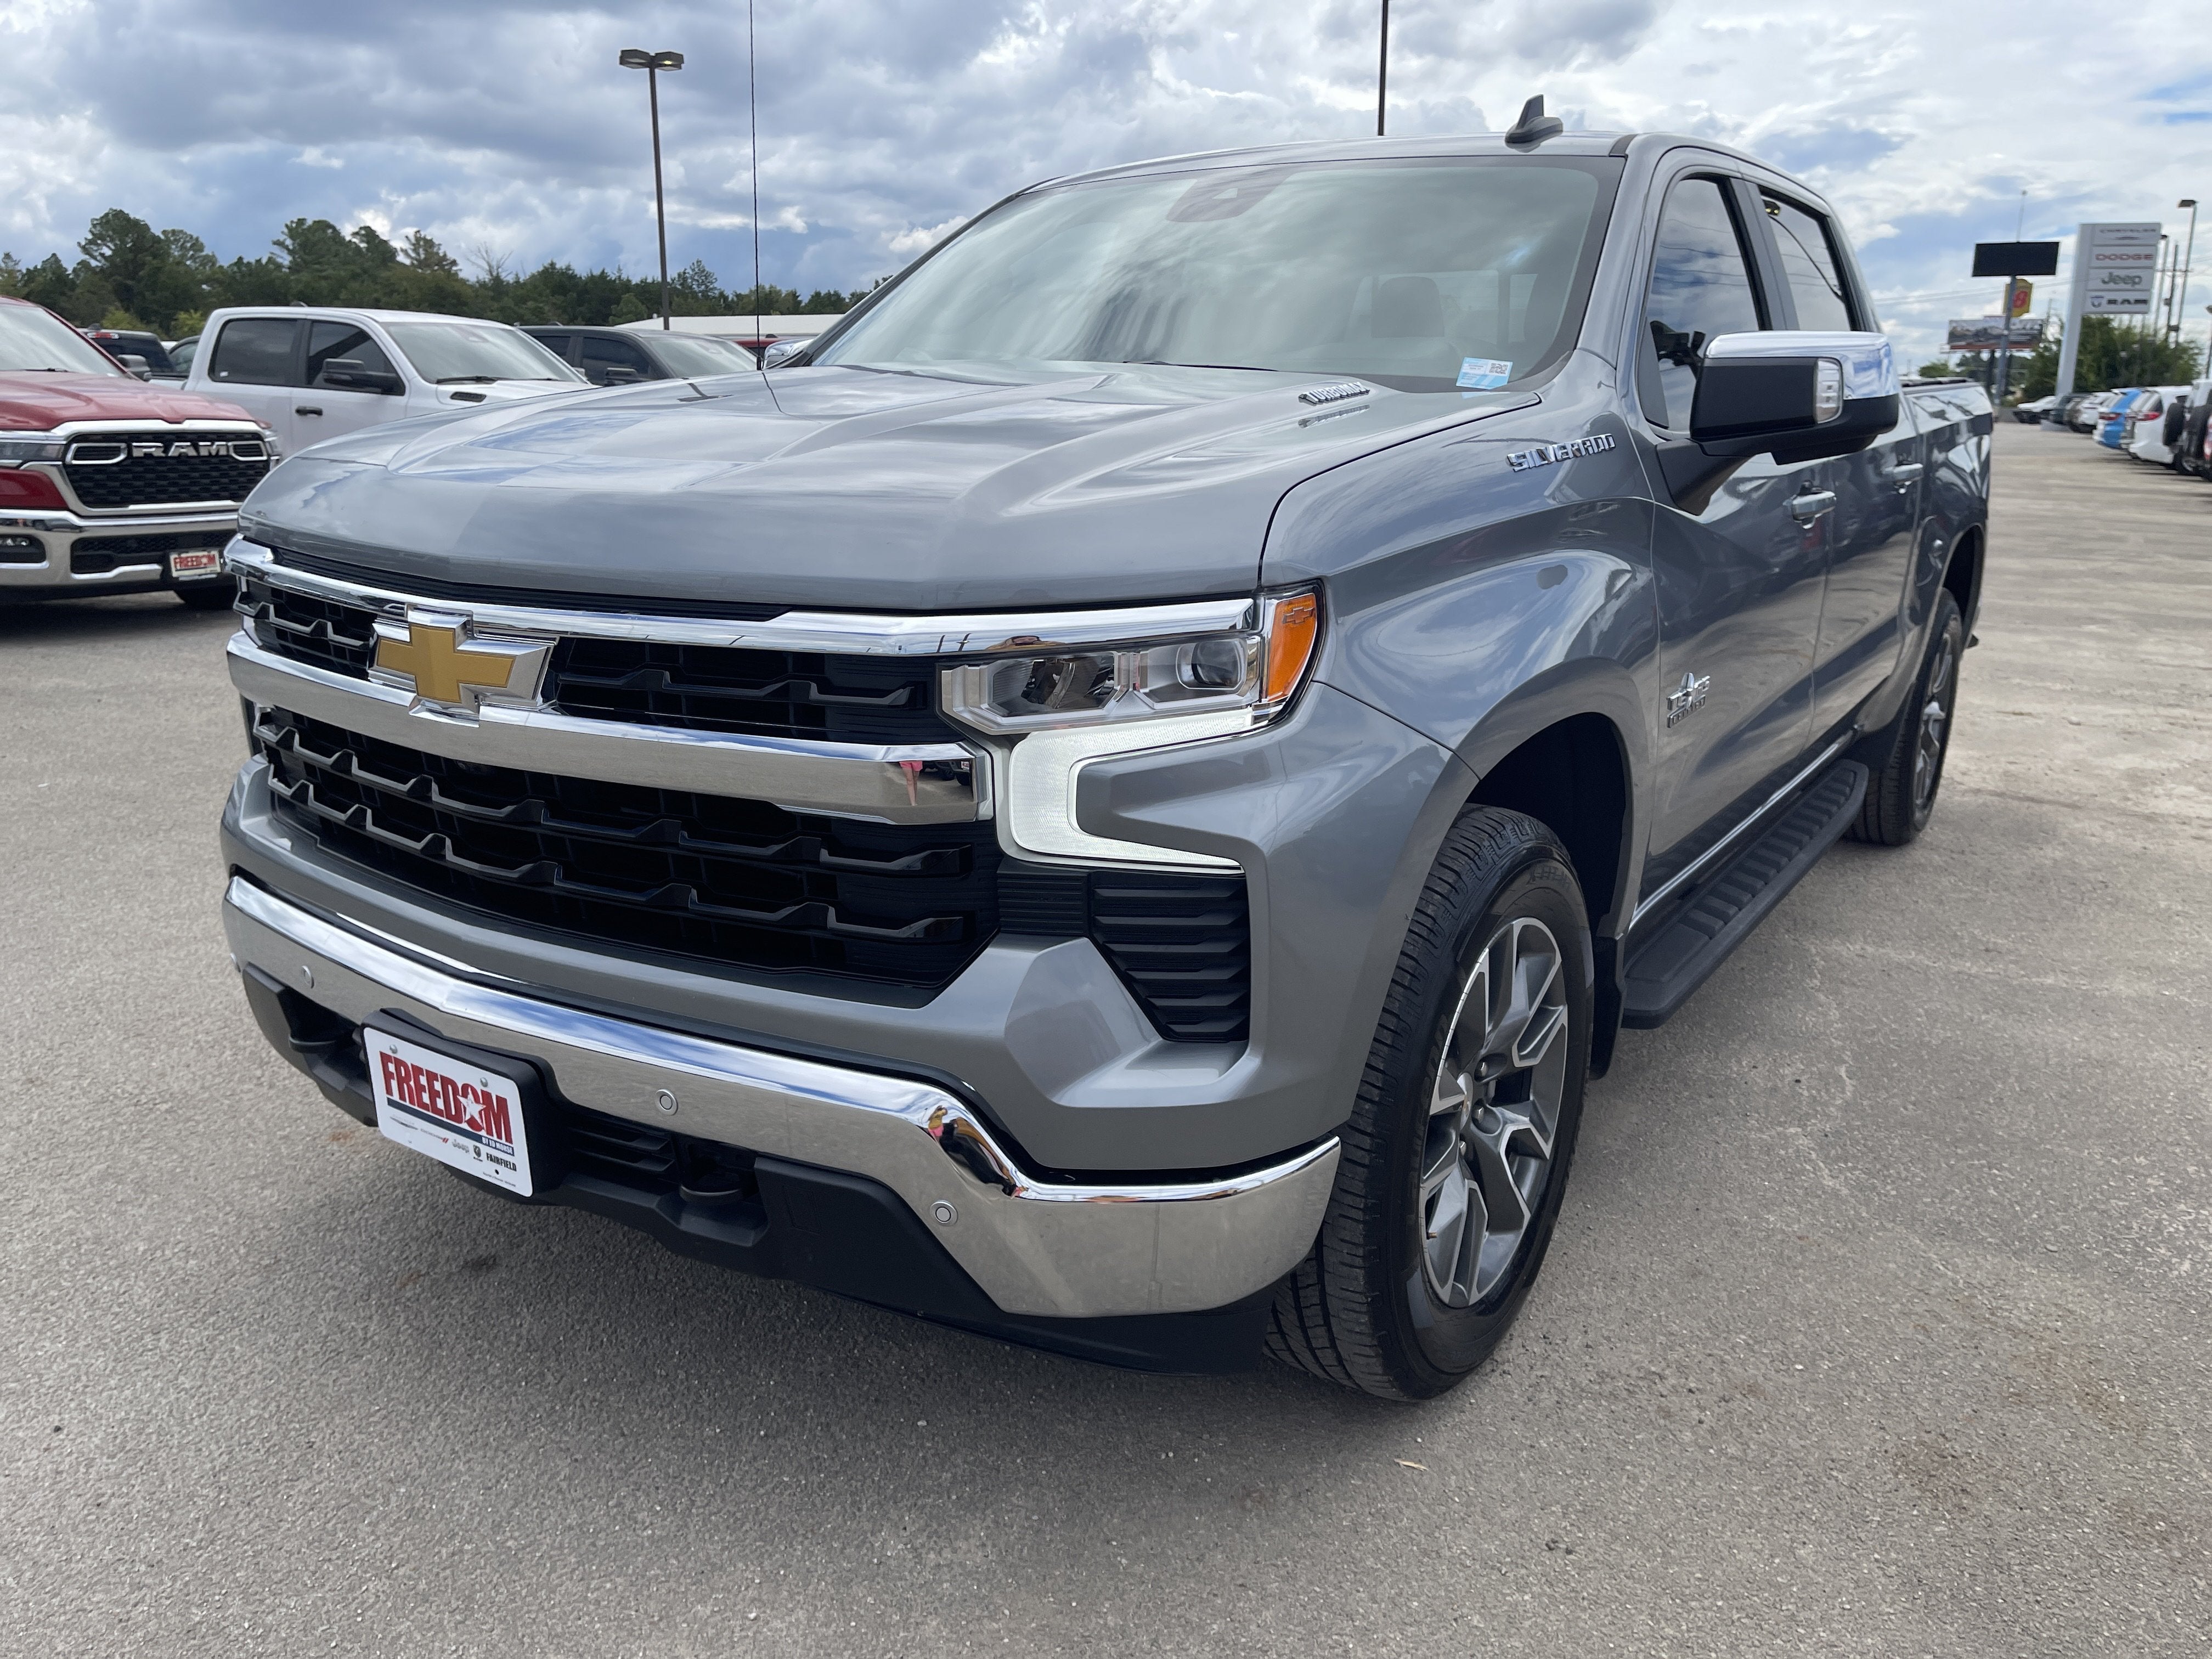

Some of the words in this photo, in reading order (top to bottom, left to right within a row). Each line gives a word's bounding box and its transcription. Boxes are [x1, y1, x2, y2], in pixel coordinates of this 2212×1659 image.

[2101, 272, 2142, 287] Jeep
[1299, 382, 1370, 404] TURBOMAX
[132, 442, 227, 457] RAM
[1506, 433, 1616, 472] SILVERADO
[379, 1051, 513, 1145] FREEDOM
[486, 1152, 517, 1172] FAIRFIELD
